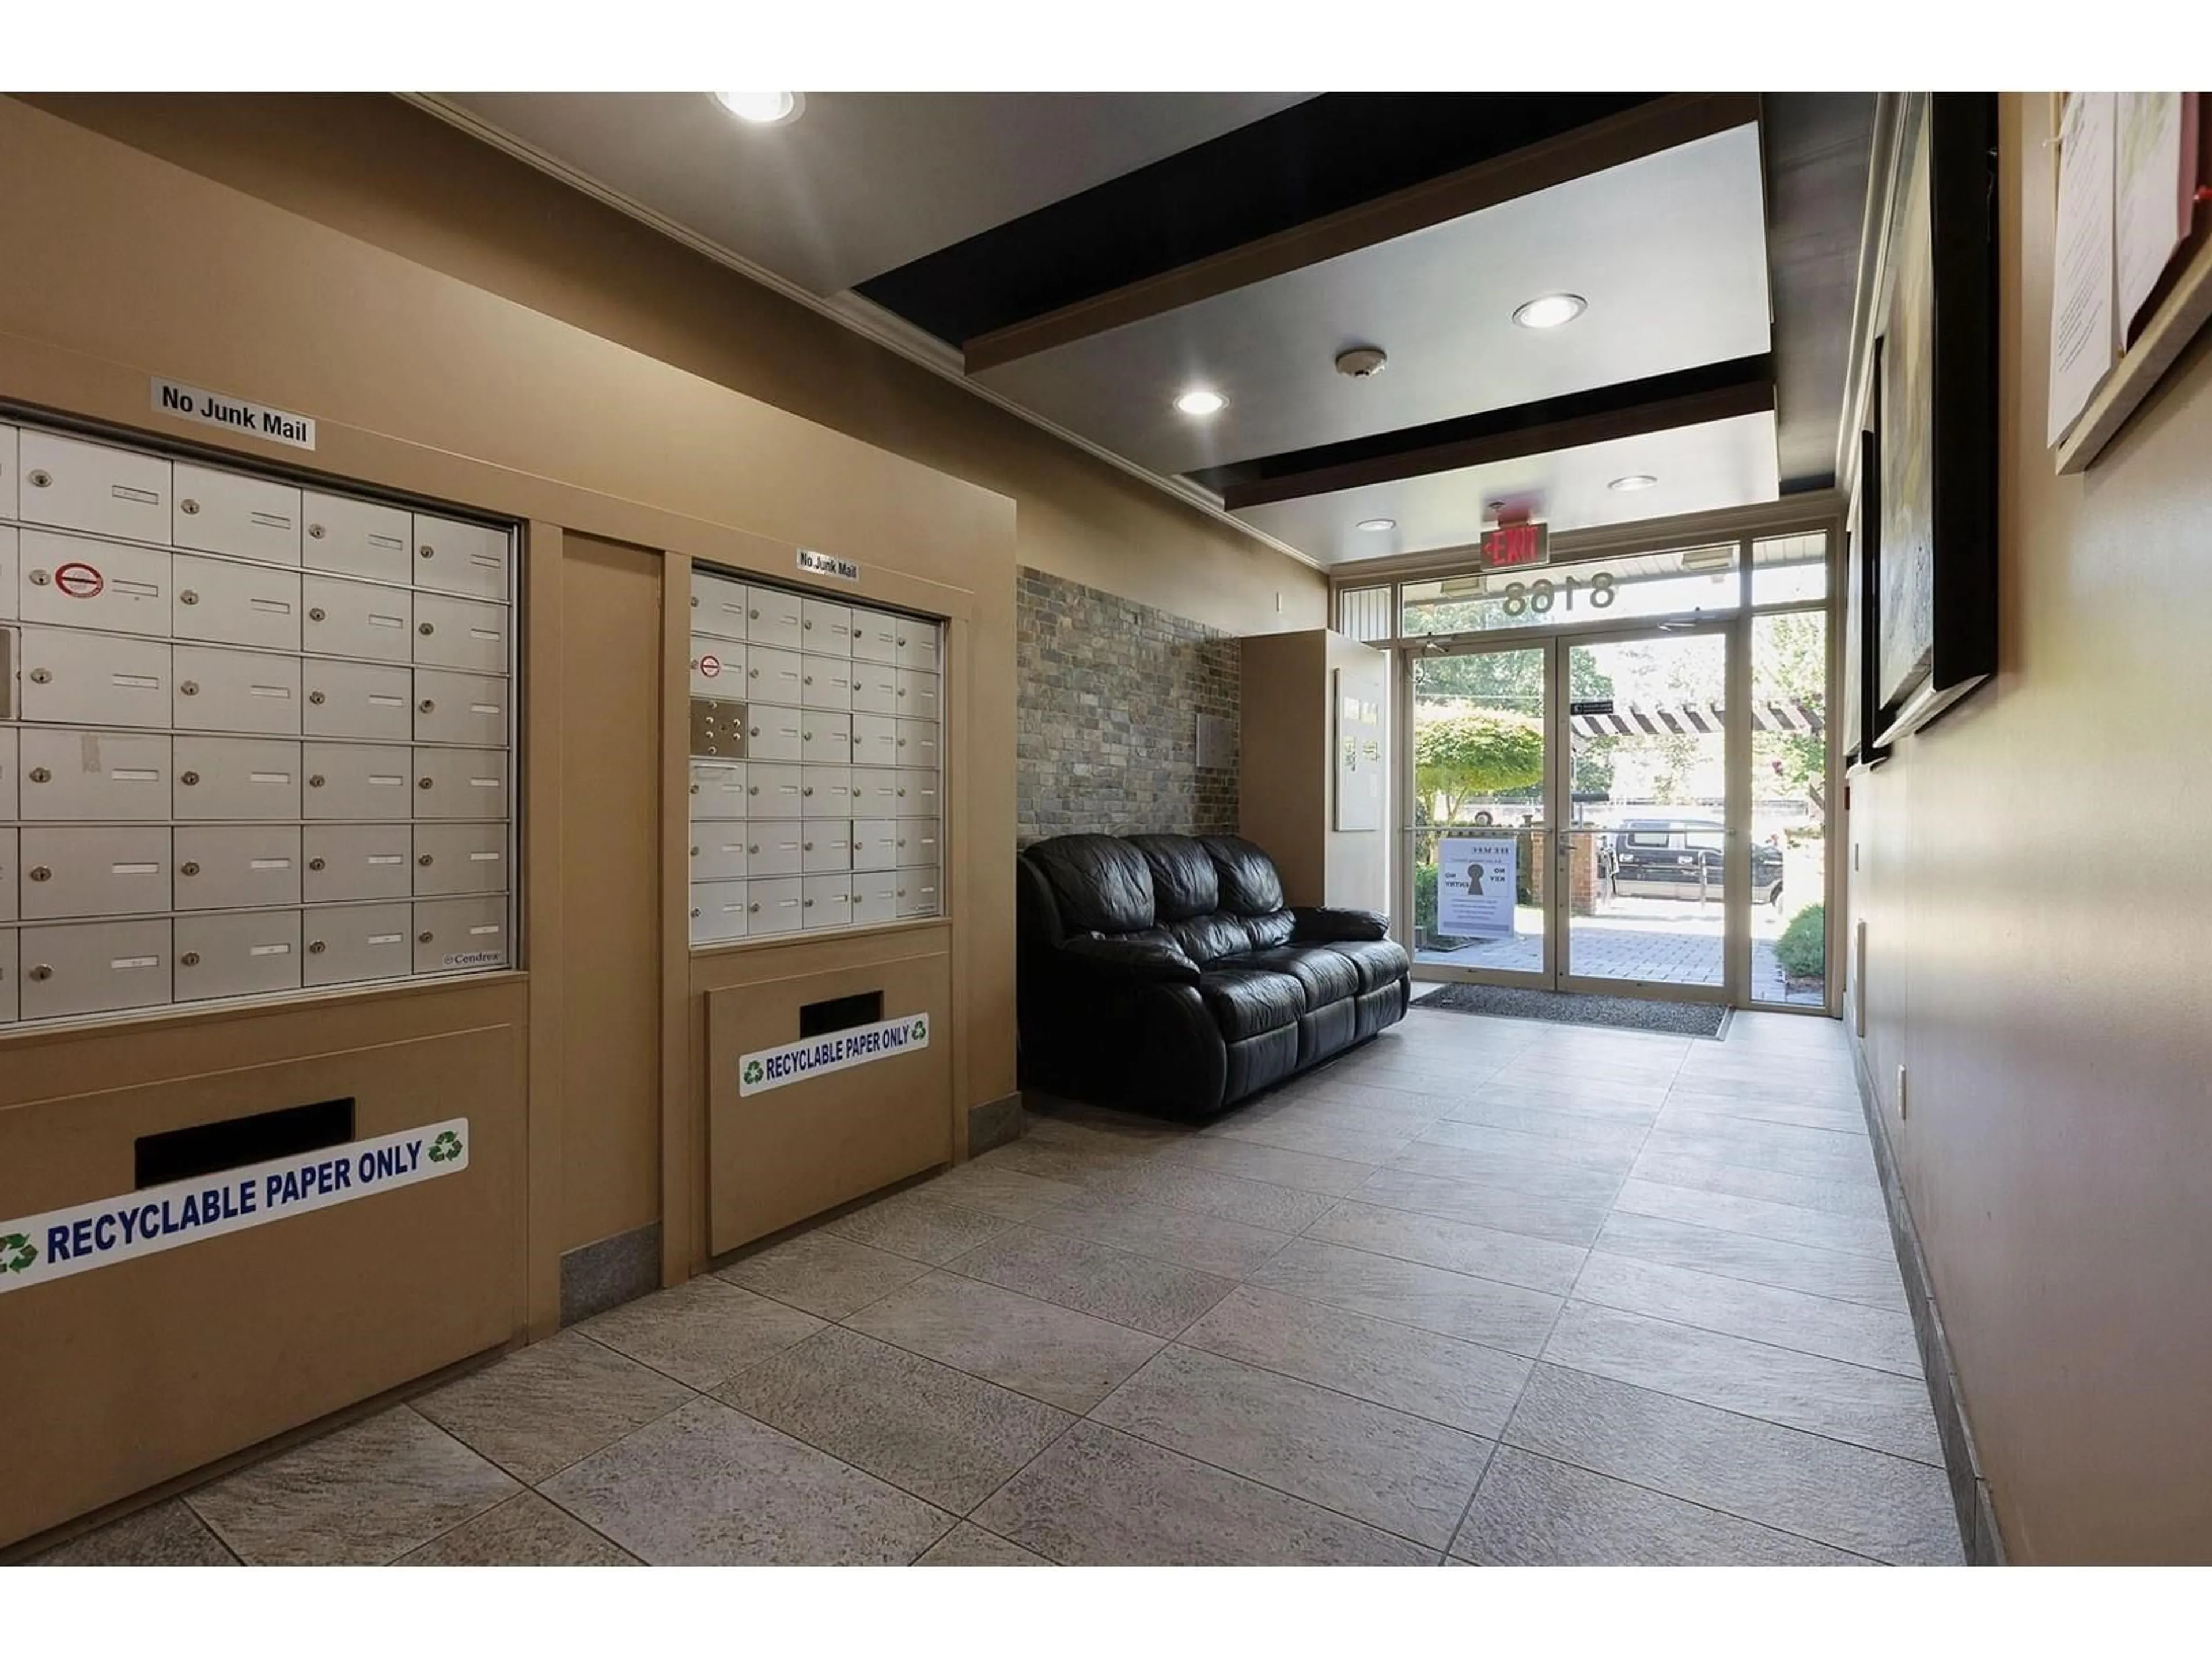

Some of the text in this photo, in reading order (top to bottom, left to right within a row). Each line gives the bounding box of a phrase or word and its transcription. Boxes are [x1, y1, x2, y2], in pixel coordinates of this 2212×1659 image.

[162, 385, 307, 442] No Junk Mail
[801, 552, 857, 578] No Junk Mail
[1493, 527, 1538, 566] EXIT
[454, 952, 498, 964] Cendrex
[767, 1024, 910, 1081] RECYCLABLE PAPER ONLY
[47, 1139, 422, 1264] RECYCLABLE PAPER ONLY
